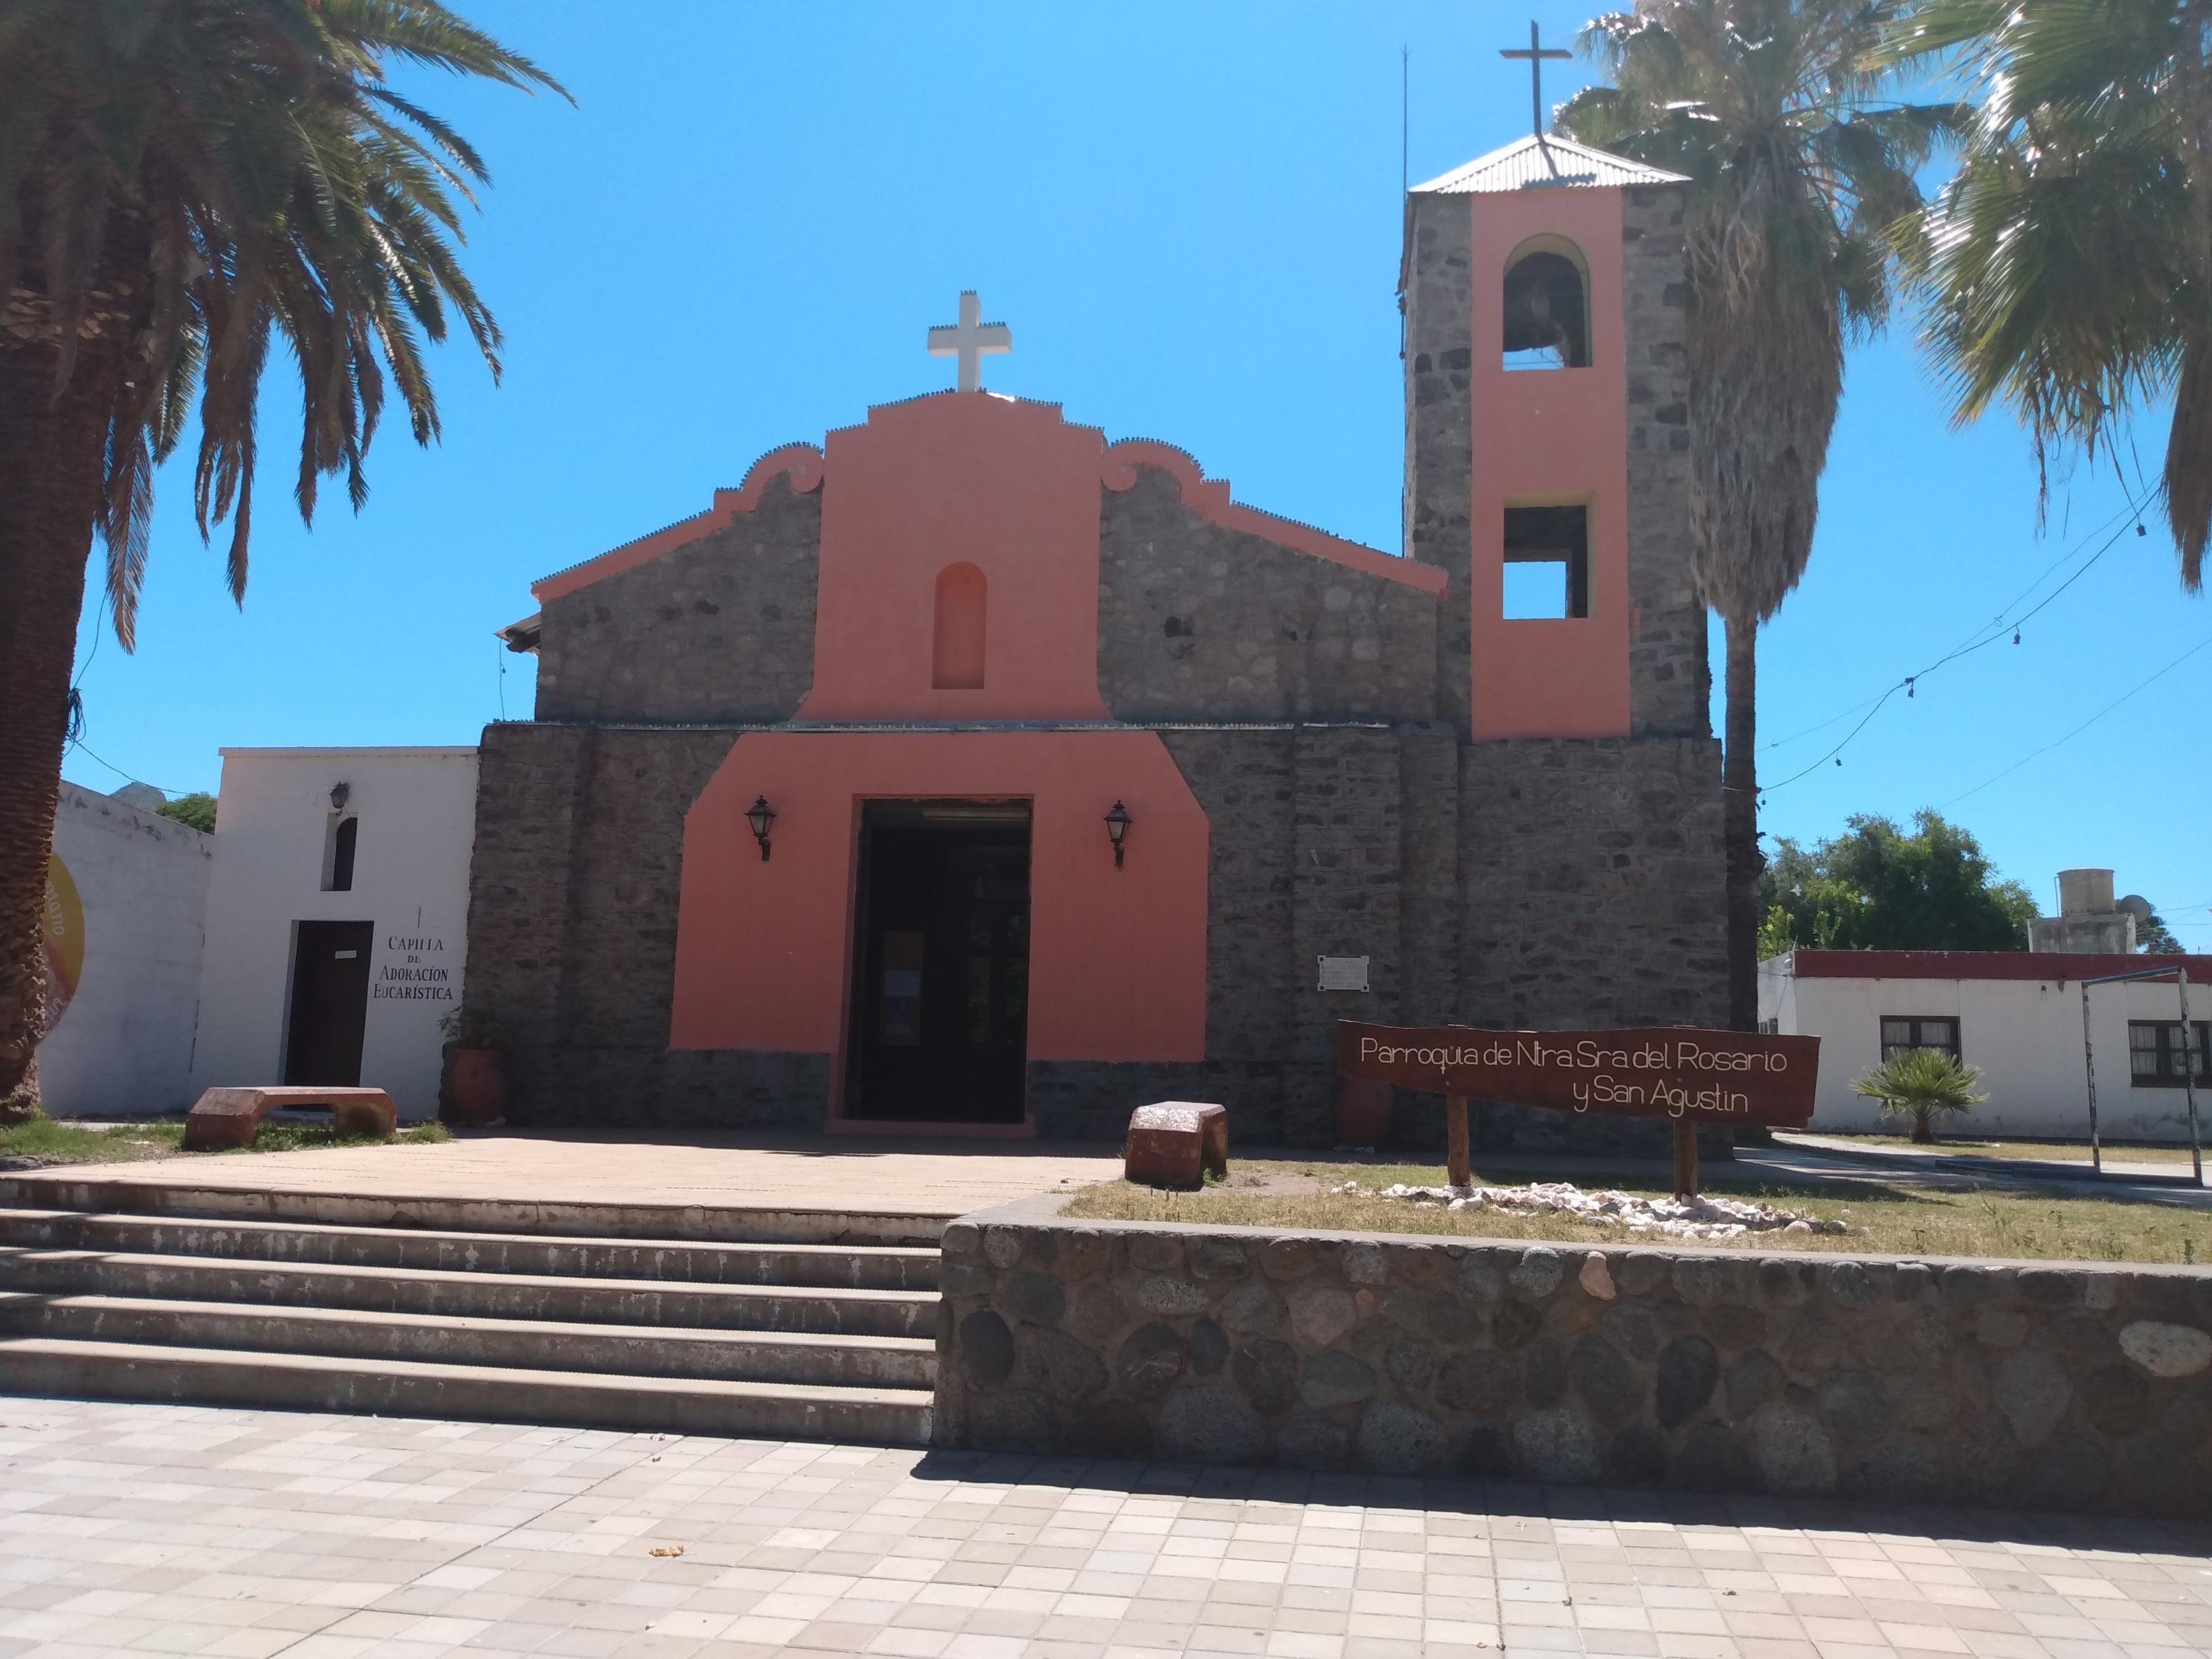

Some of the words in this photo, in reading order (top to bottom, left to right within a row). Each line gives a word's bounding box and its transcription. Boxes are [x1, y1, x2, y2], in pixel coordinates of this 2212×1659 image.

[374, 983, 452, 1000] EUCARÍSTICA
[1361, 1037, 1479, 1075] Parroquia
[1483, 1040, 1512, 1066] de
[1517, 1040, 1574, 1068] Ntra
[1577, 1040, 1629, 1068] Sra
[1632, 1042, 1672, 1069] del
[1677, 1041, 1787, 1072] Rosario
[1573, 1082, 1589, 1112] y
[1593, 1075, 1645, 1104] San
[1650, 1078, 1748, 1118] Agustin
